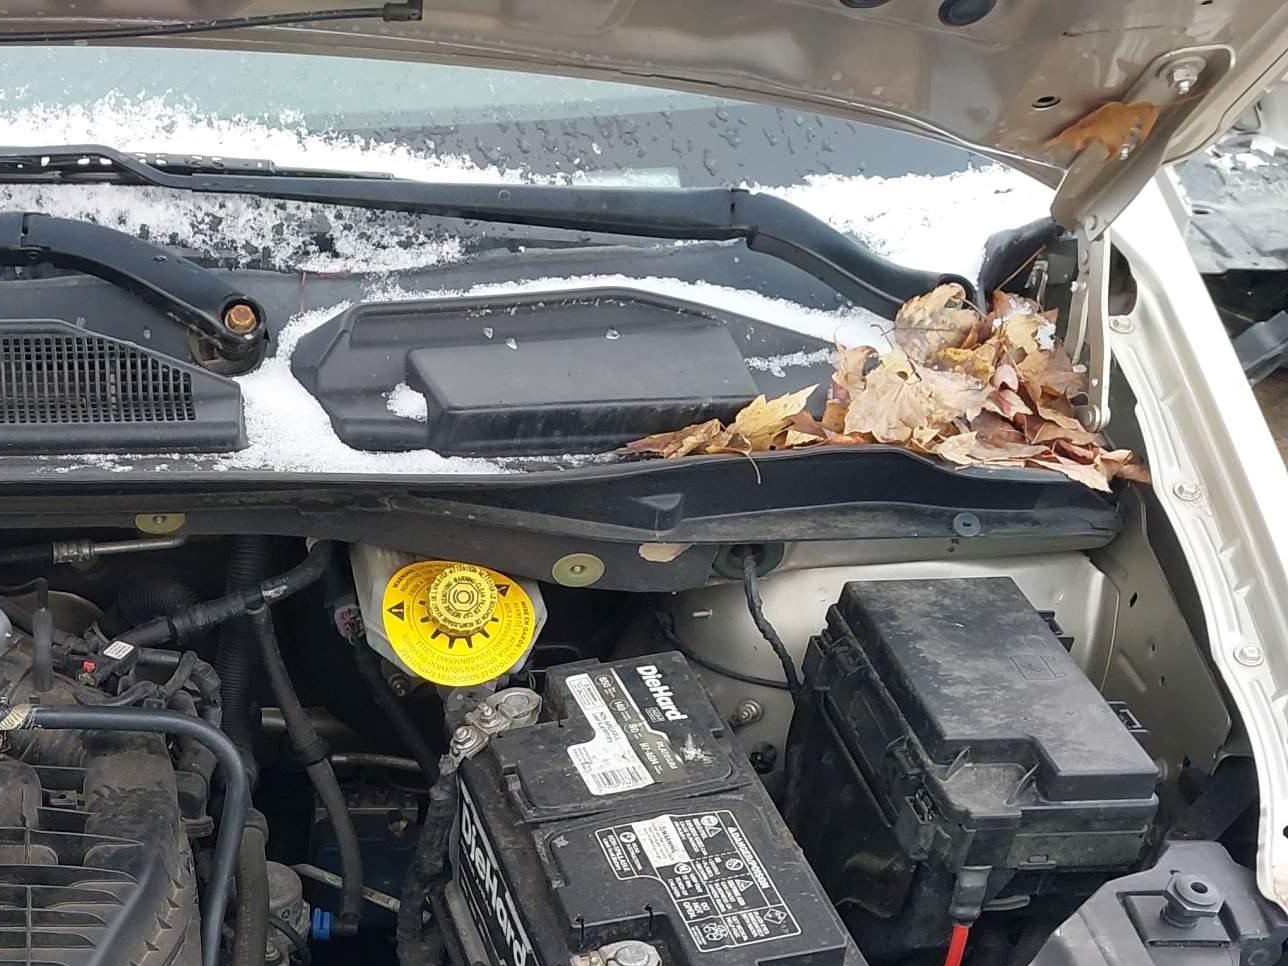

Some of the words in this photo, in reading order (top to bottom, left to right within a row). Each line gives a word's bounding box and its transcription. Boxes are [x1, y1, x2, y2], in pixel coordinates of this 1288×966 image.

[636, 665, 688, 721] DieHard
[614, 701, 626, 711] 140
[656, 741, 678, 769] PLATINUM
[730, 832, 770, 888] DANGER/POISON
[690, 901, 704, 914] NOT
[700, 901, 711, 910] DO
